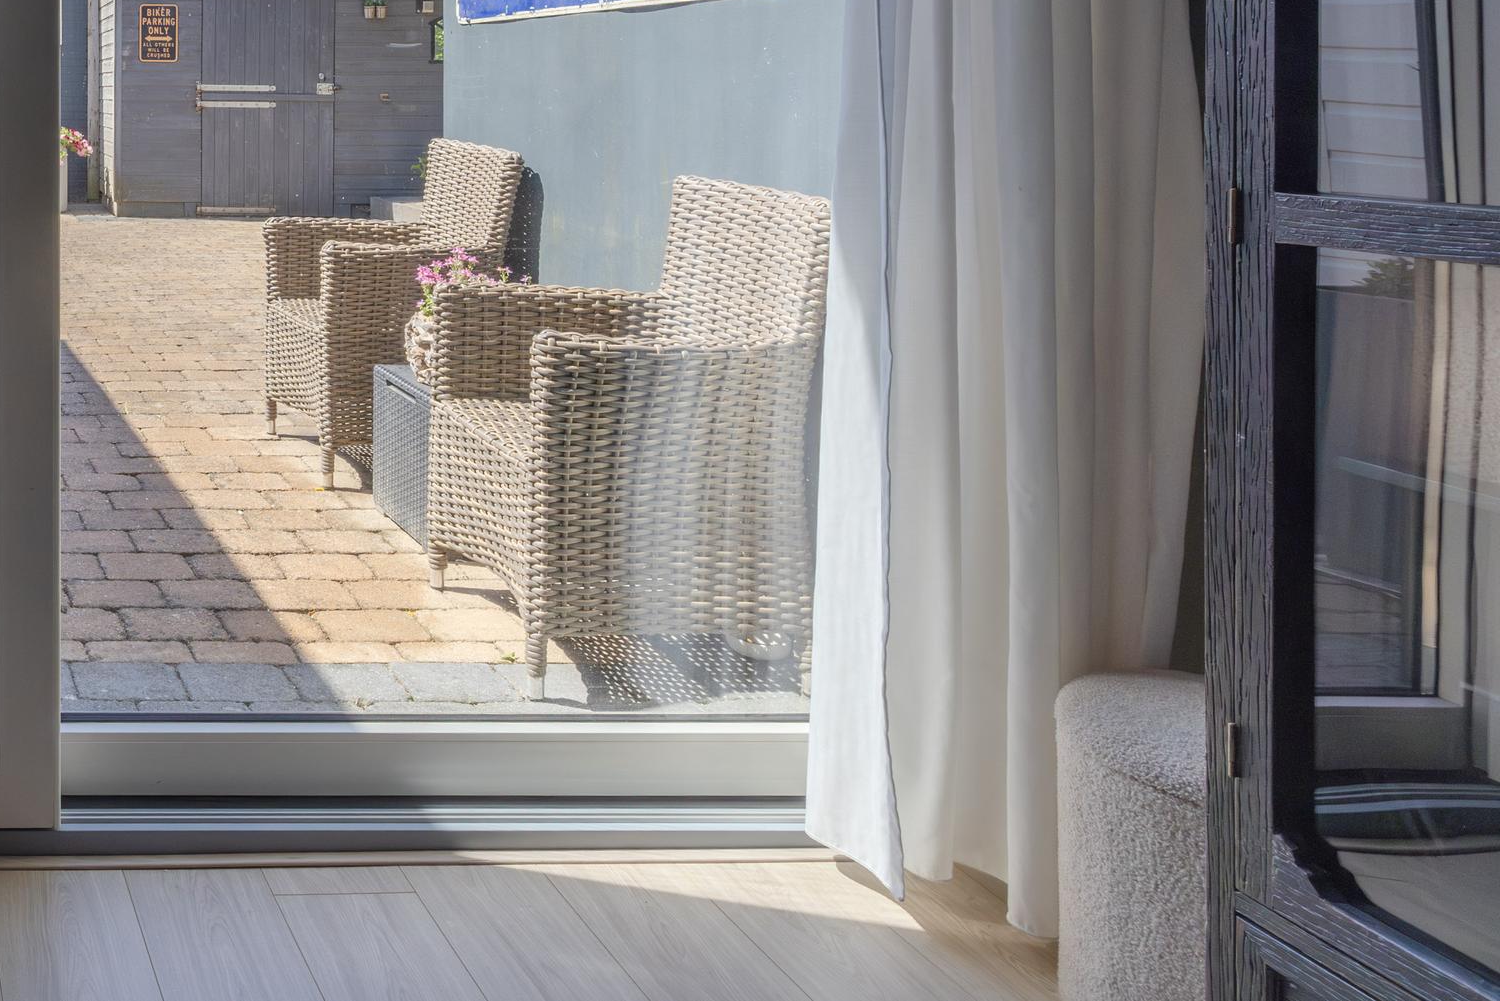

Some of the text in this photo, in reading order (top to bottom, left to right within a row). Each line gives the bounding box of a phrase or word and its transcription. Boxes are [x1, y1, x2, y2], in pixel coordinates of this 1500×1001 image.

[147, 8, 170, 16] BIKER
[142, 17, 175, 25] PARKING
[148, 26, 169, 35] ONLY
